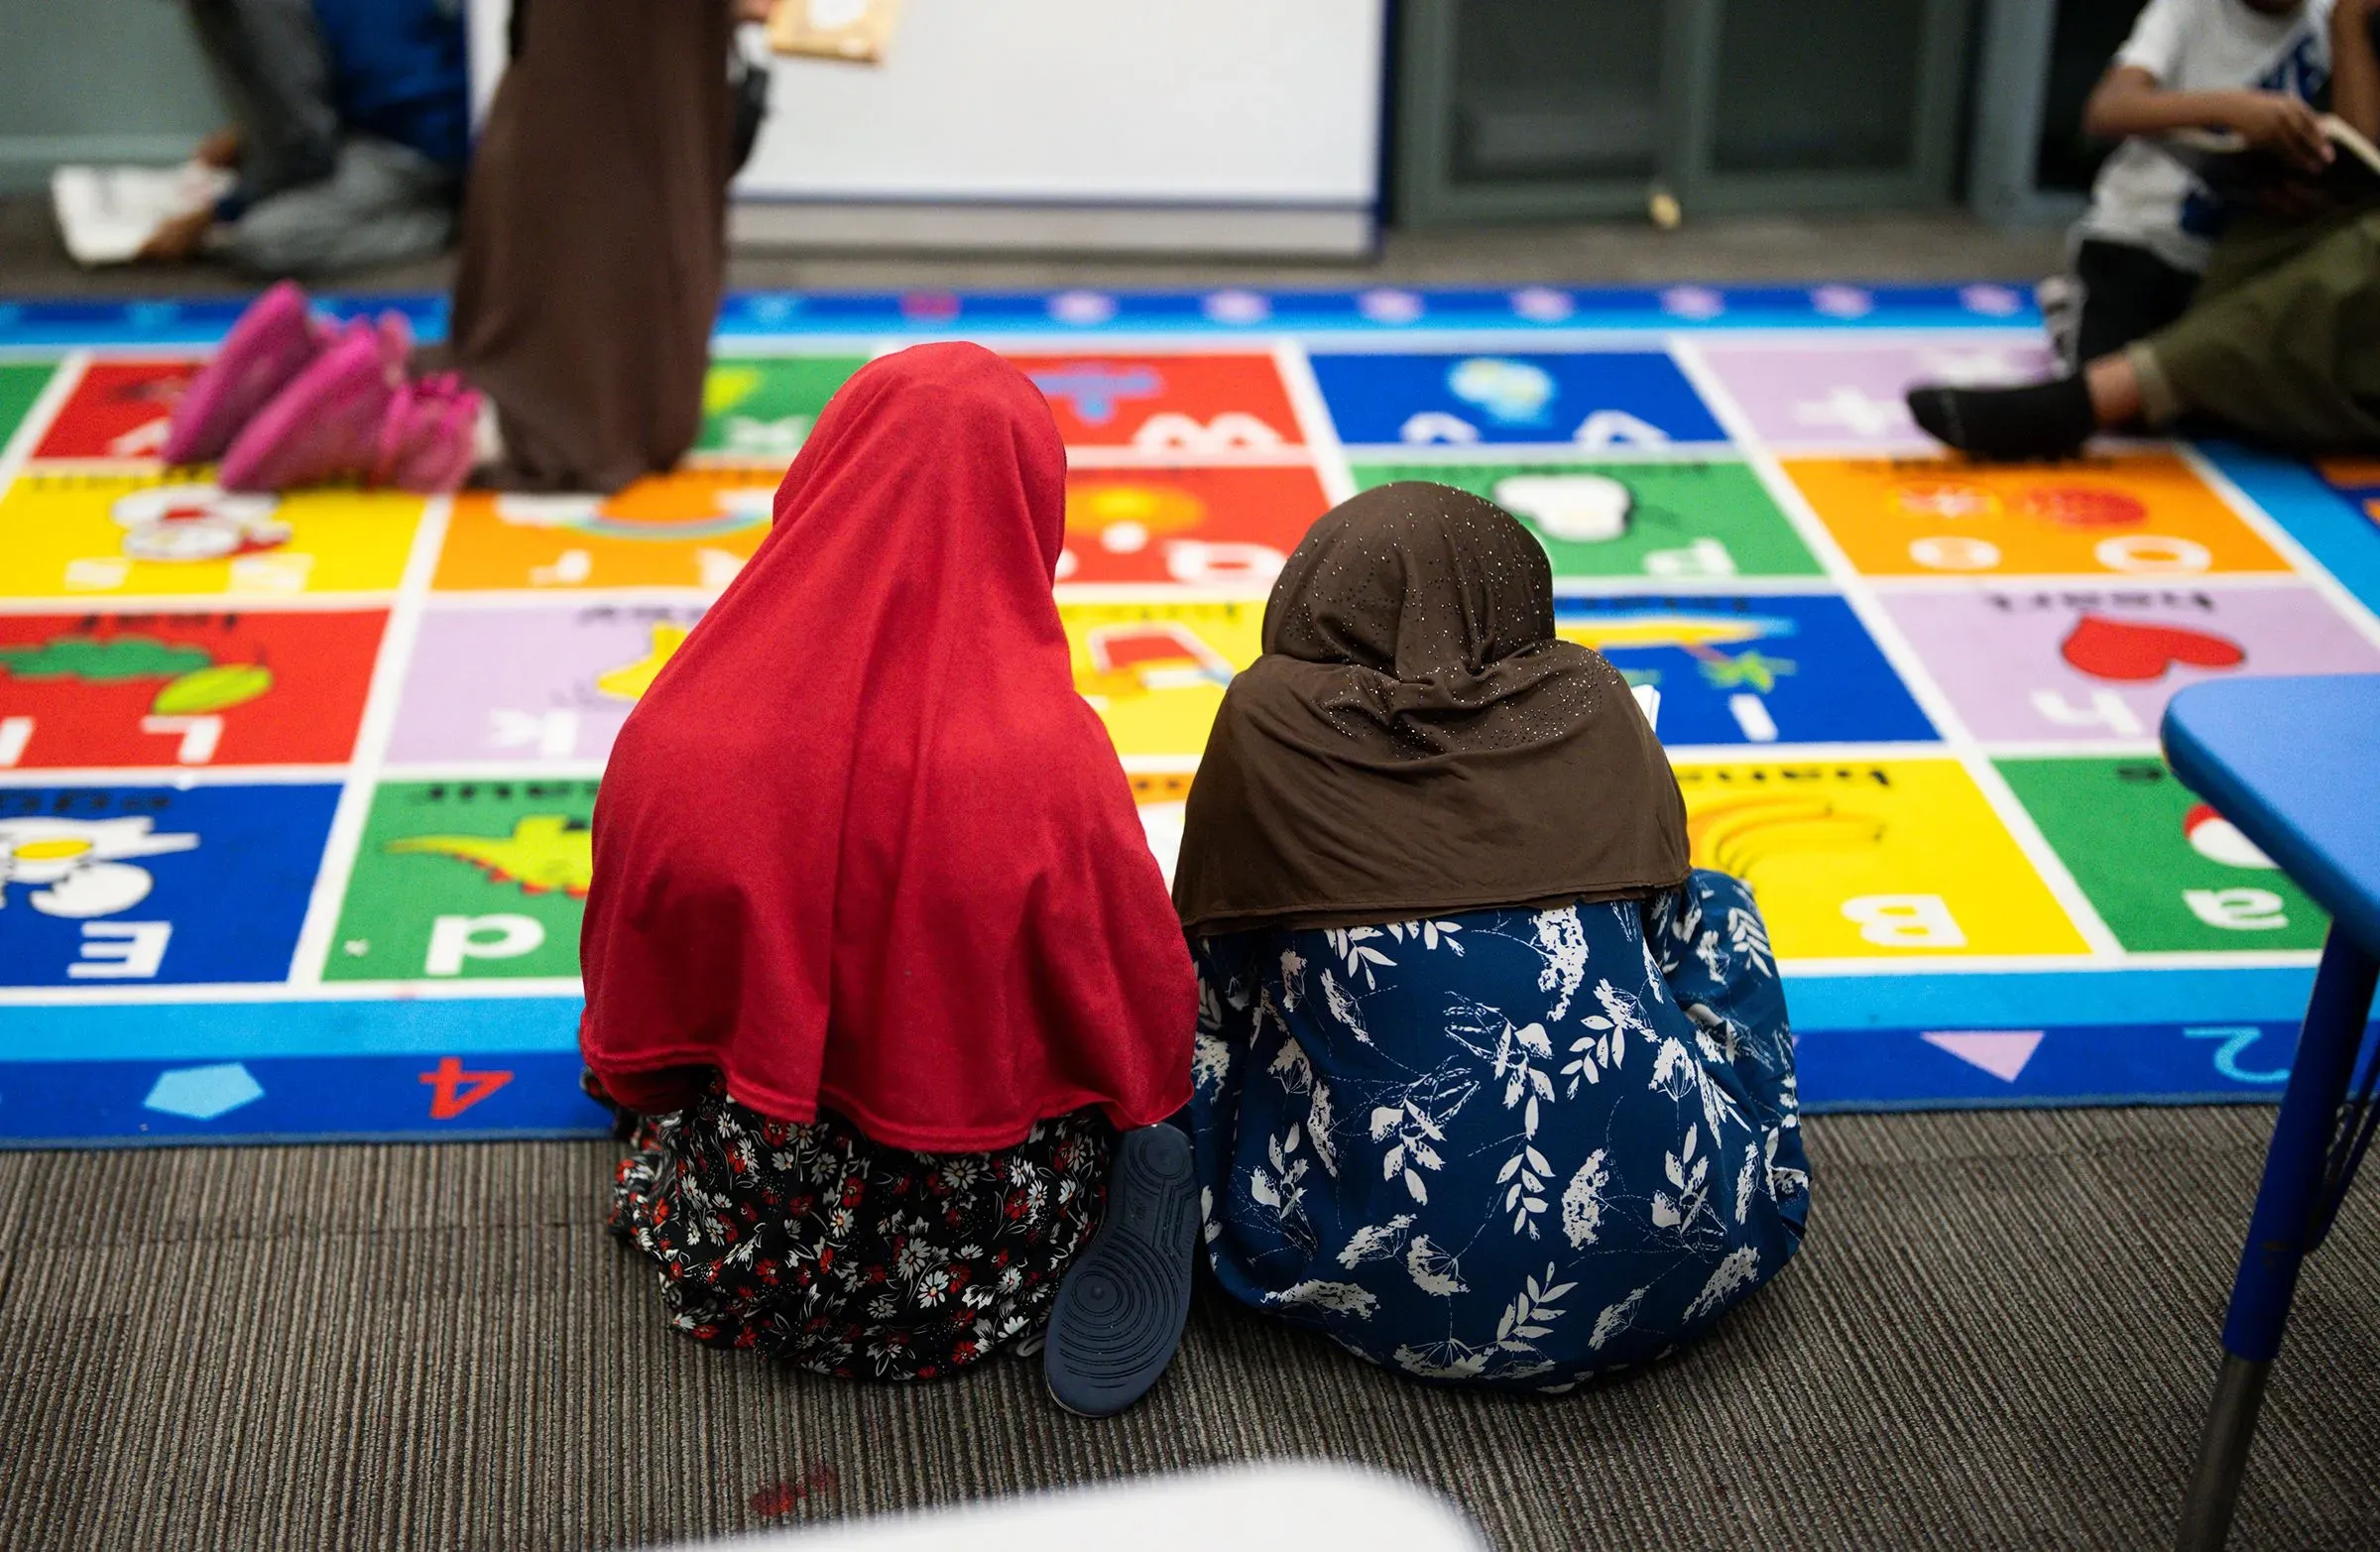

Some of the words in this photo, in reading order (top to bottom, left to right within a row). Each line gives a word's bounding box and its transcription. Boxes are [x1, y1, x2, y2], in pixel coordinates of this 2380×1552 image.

[139, 713, 224, 765] L
[1841, 893, 1967, 948] B
[2181, 887, 2290, 931] a
[65, 920, 173, 979] E
[424, 911, 546, 976] d
[2183, 1025, 2292, 1084] 2
[419, 1056, 514, 1120] 4
